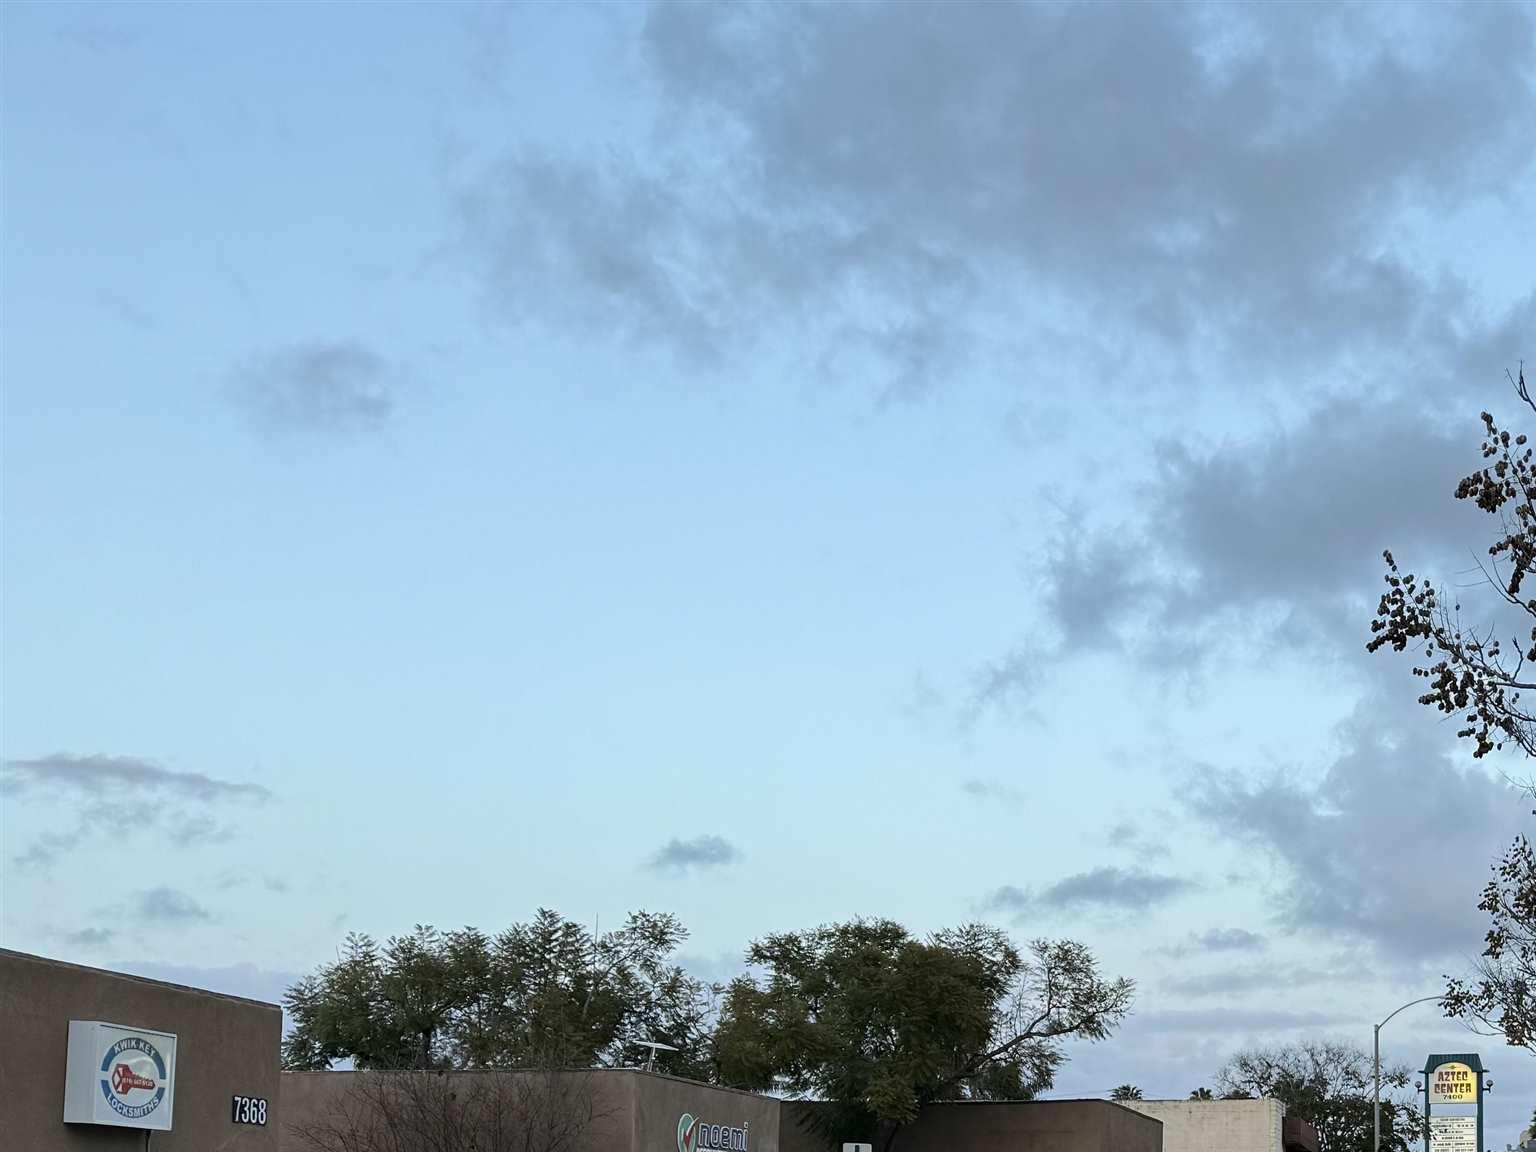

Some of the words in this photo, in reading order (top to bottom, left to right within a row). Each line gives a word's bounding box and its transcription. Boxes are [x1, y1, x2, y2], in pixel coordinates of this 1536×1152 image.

[1434, 1083, 1472, 1093] CENTER
[1438, 1071, 1468, 1082] AZTEC
[107, 1094, 159, 1117] LOCKSMITHS
[234, 1096, 267, 1125] 7368
[699, 1121, 749, 1152] noemi
